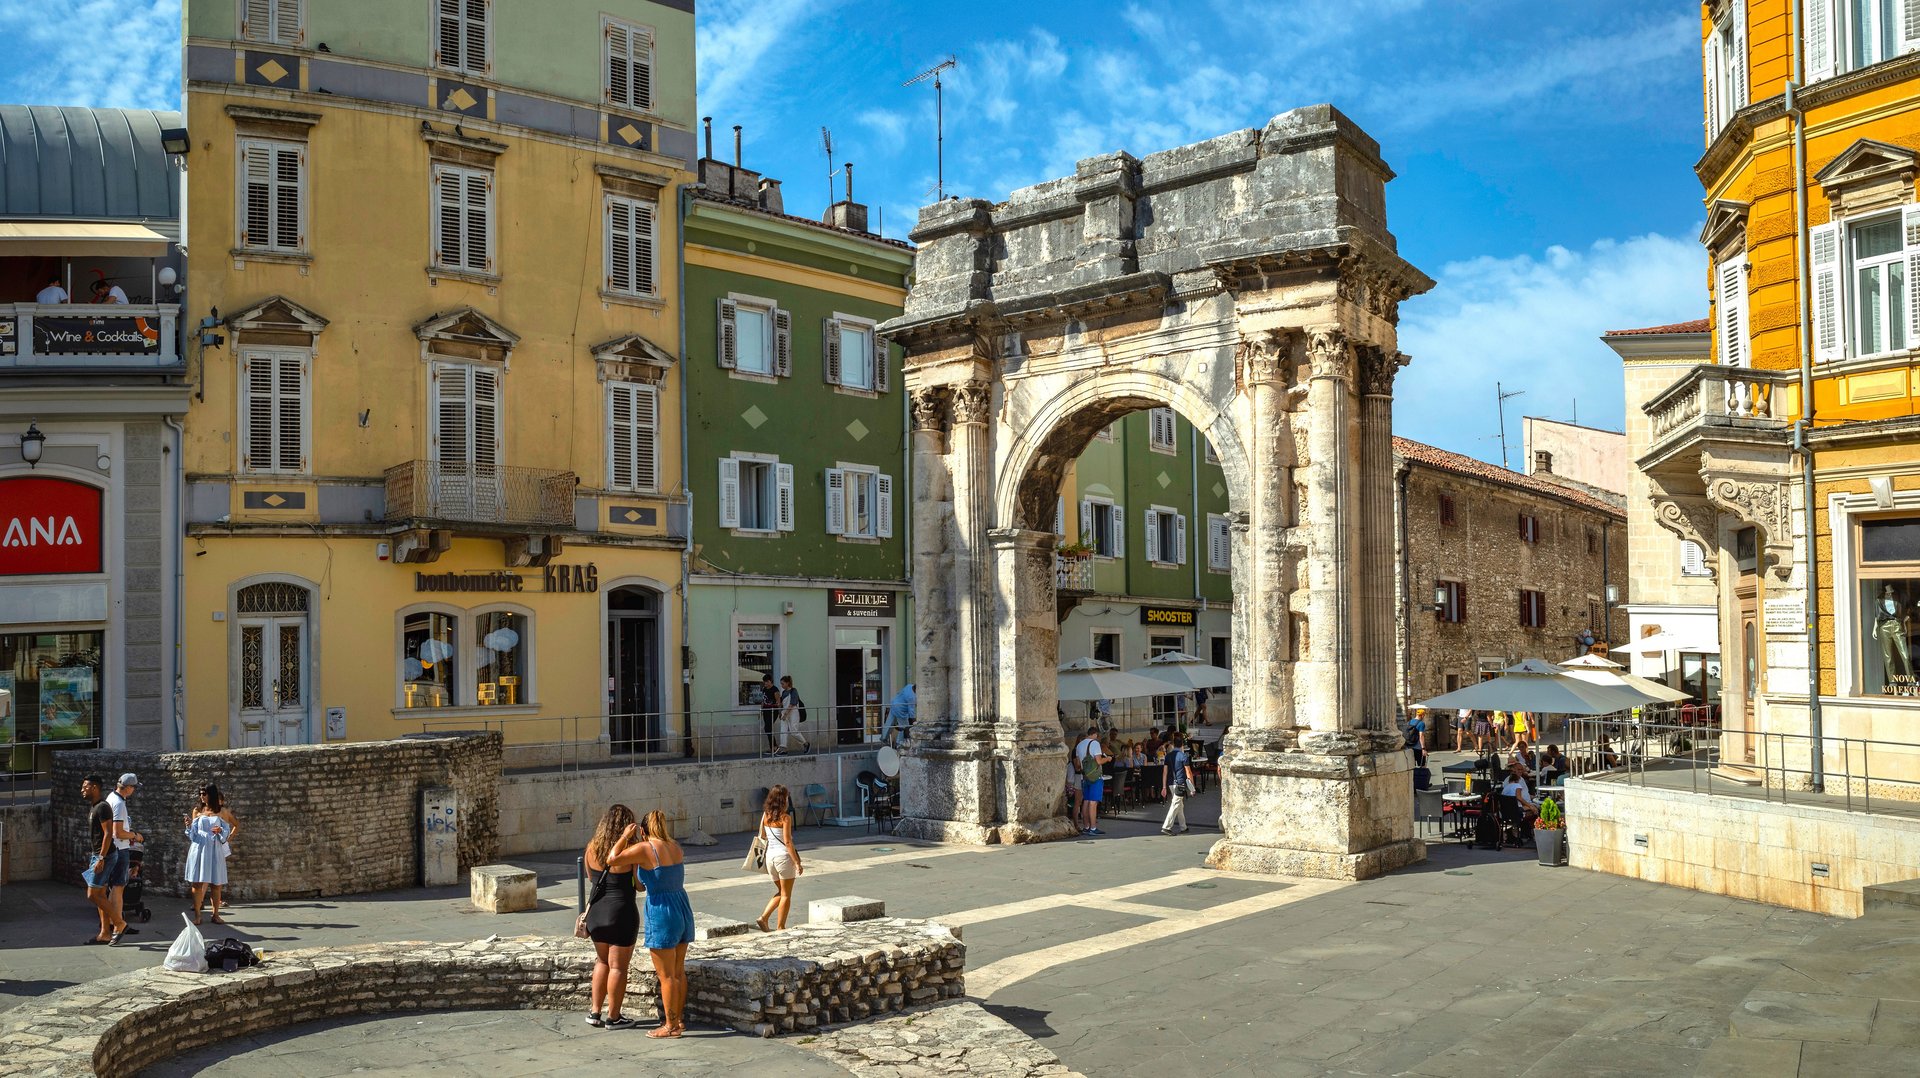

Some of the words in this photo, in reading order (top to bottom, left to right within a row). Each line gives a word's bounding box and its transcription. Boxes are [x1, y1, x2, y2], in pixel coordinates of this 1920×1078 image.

[50, 331, 82, 342] Wine
[84, 331, 94, 342] &
[96, 331, 143, 342] Cocktails
[2, 515, 83, 548] ANA
[545, 563, 598, 593] KRAŠ
[1147, 610, 1193, 623] SHOOSTER
[1891, 674, 1916, 683] NOVA
